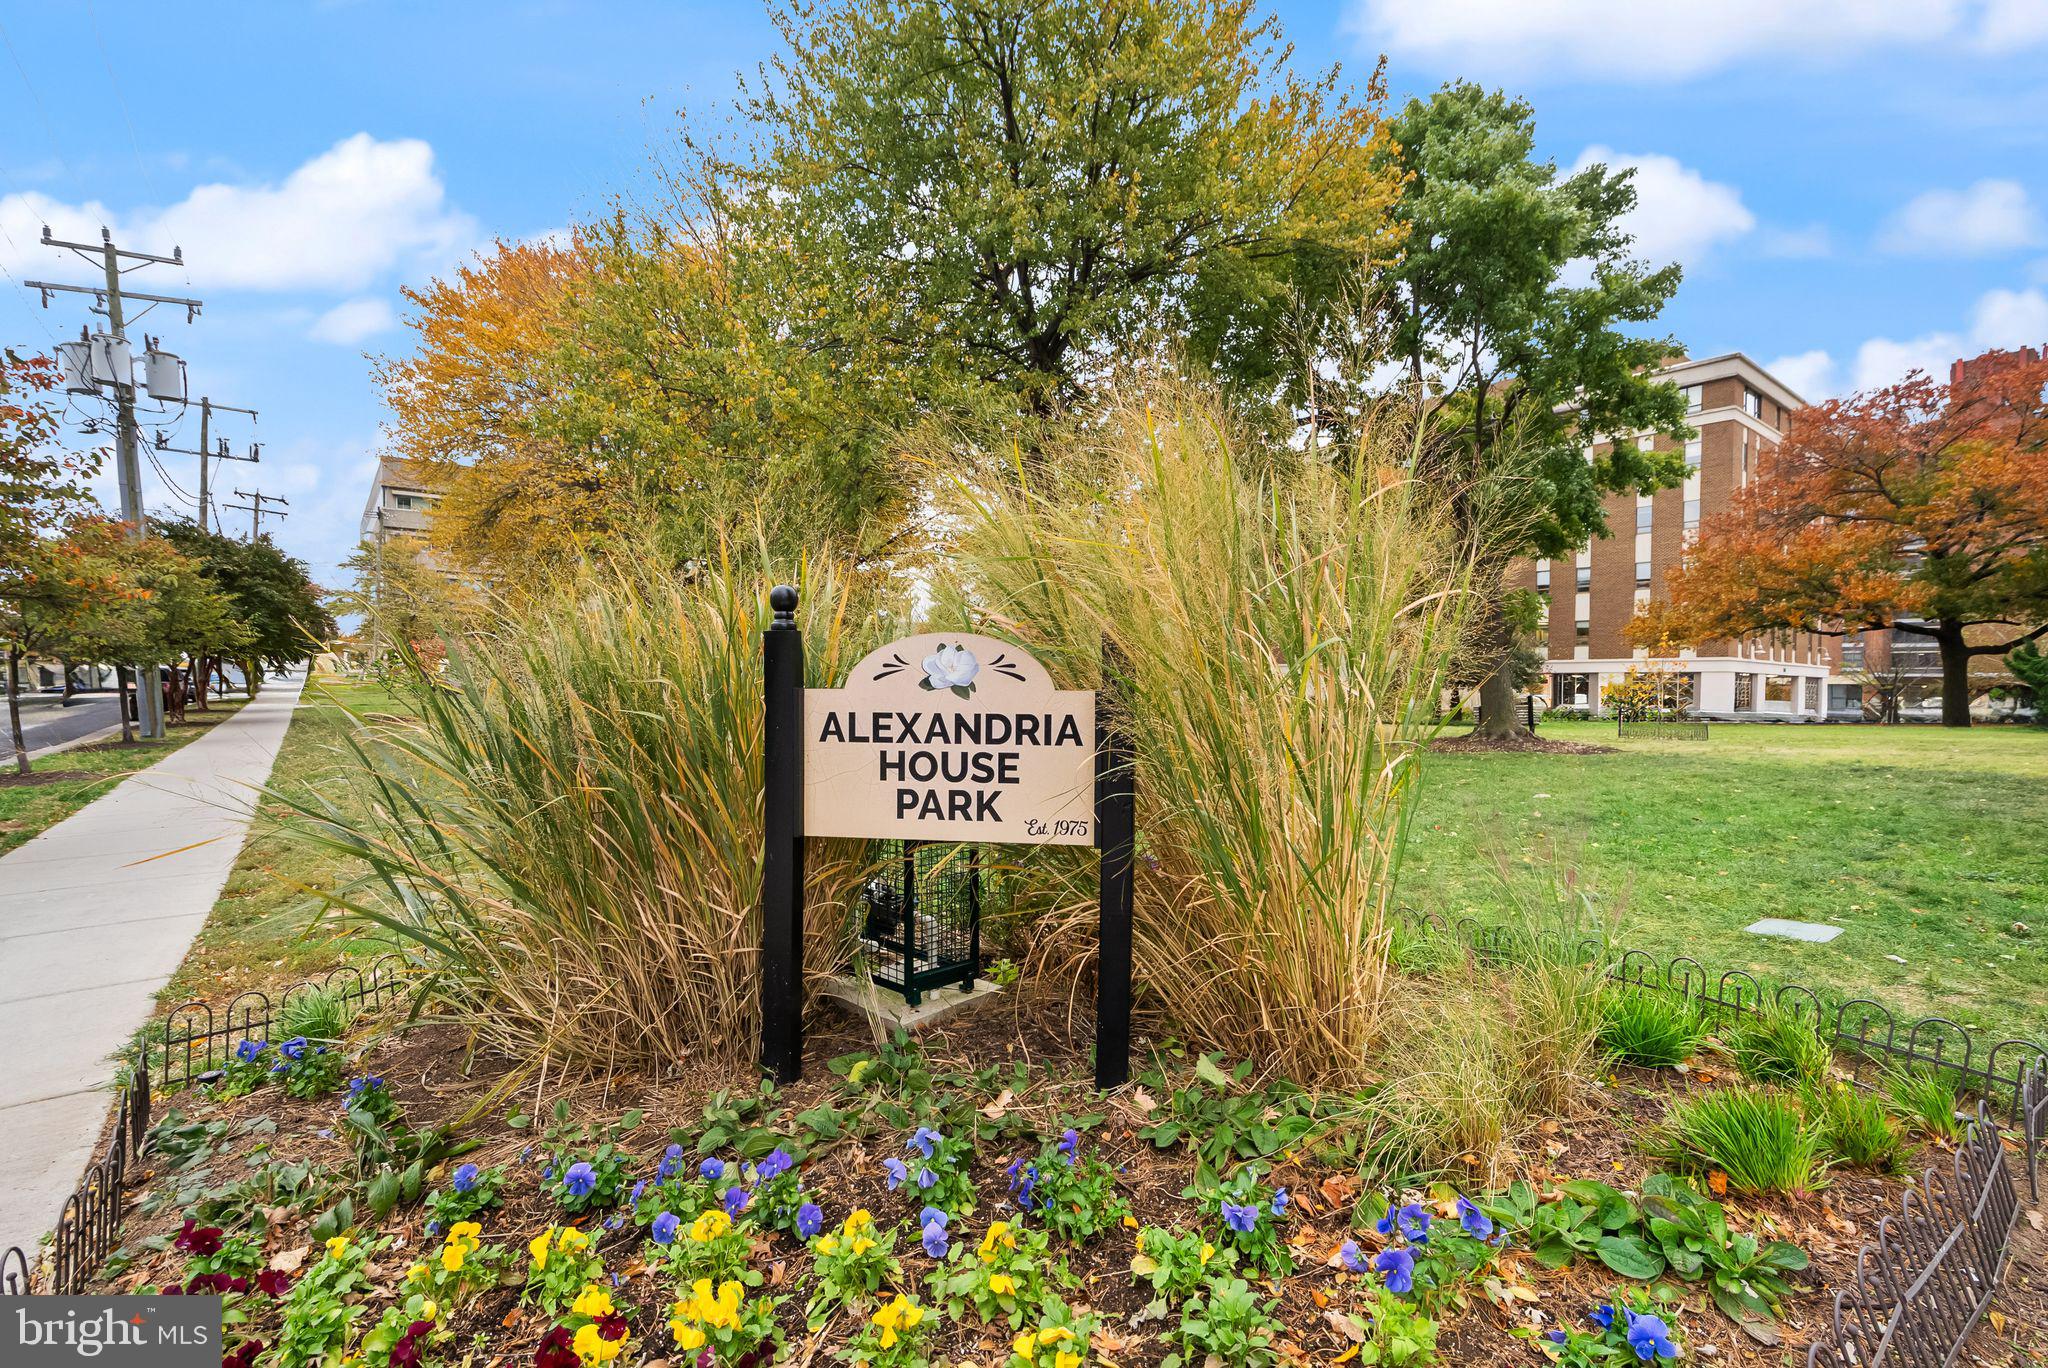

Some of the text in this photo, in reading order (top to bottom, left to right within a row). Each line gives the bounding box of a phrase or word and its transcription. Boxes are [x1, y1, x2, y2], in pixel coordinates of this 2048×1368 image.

[819, 711, 1084, 747] ALEXANDRIA
[879, 750, 1020, 784] HOUSE
[896, 788, 1003, 822] PARK
[1024, 818, 1089, 837] Est. 1975
